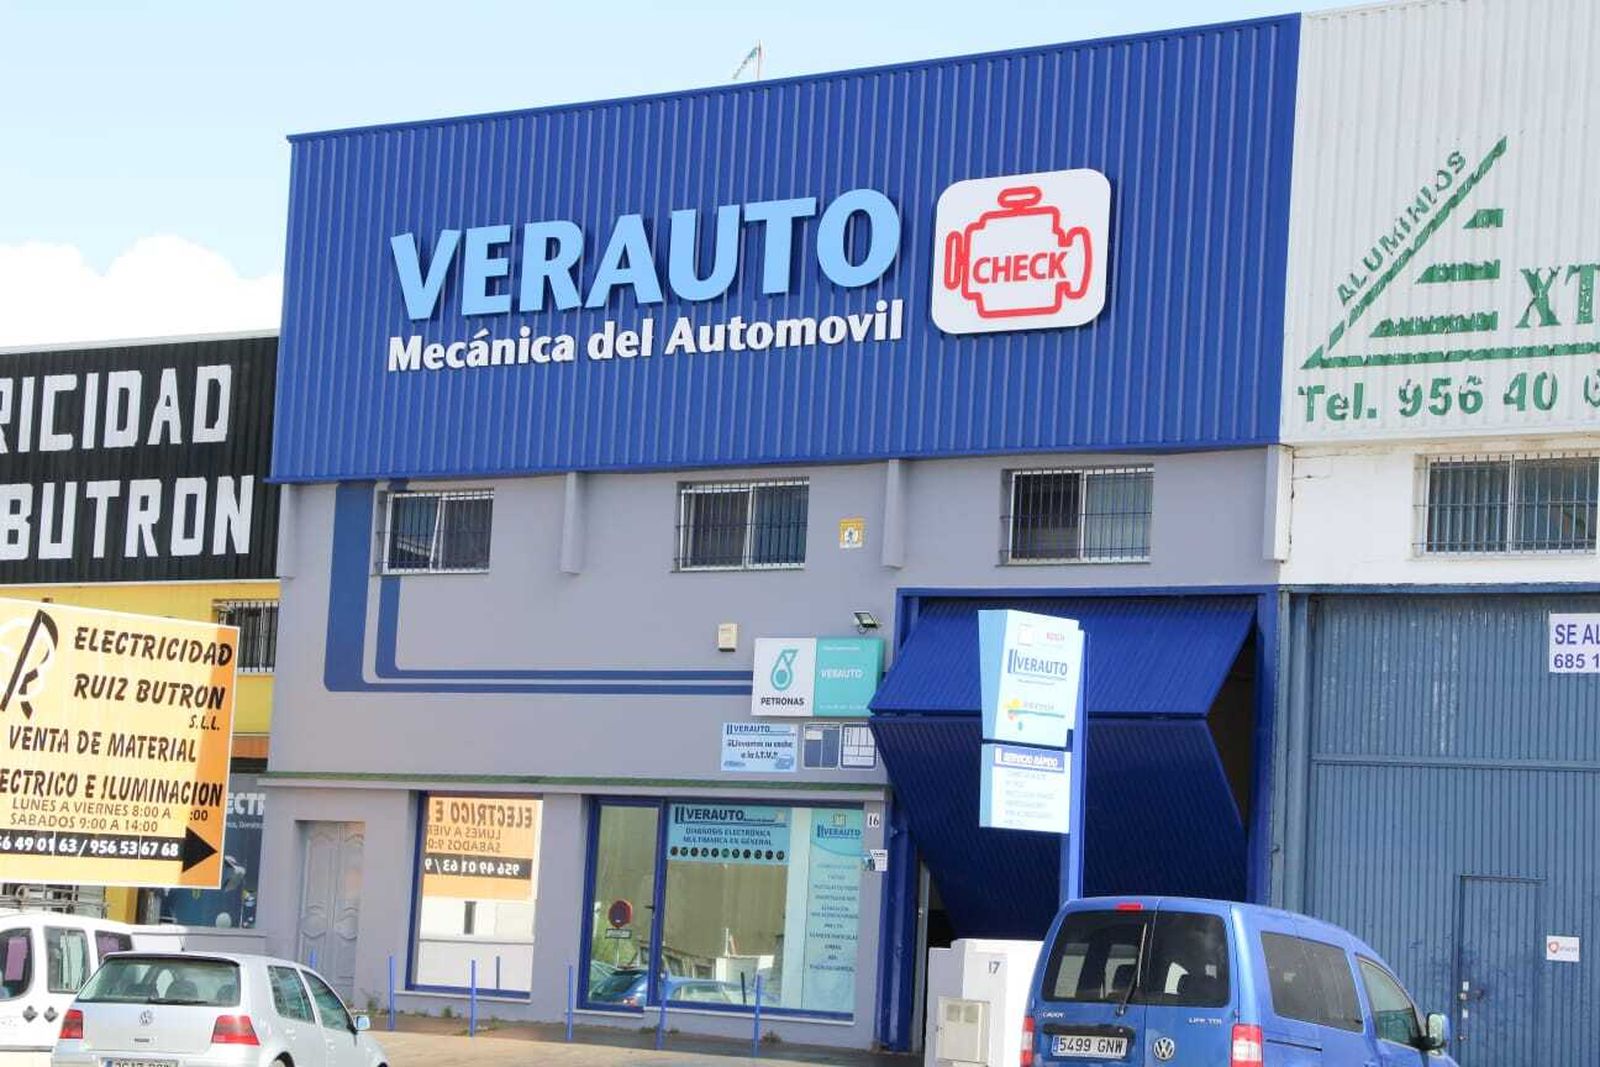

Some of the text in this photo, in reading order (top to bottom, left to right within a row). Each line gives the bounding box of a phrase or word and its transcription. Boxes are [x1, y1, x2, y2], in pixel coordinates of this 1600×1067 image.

[1337, 151, 1466, 306] ALUMINIOS
[390, 188, 901, 321] VERAUTO
[973, 252, 1068, 284] CHECK
[387, 299, 903, 372] Mecánica del Automovil
[1298, 382, 1377, 422] Tel.
[1398, 375, 1483, 417] 956
[1503, 371, 1558, 411] 40
[0, 475, 254, 561] BUTRON
[1555, 624, 1577, 645] SE
[75, 626, 233, 666] ELECTRICIDAD
[1016, 656, 1068, 676] VERAUTO
[1554, 653, 1585, 668] 685
[820, 669, 863, 679] VERAUTO
[74, 673, 226, 710] RUIZ BUTRON
[760, 697, 805, 706] PETRONAS
[189, 714, 221, 731] S.L.L.
[734, 725, 770, 733] VERAUTO
[9, 725, 197, 763] VENTA DE MATERIAL
[0, 769, 224, 807] ECTRICO E ILUMINACION
[12, 797, 56, 812] LUNES
[60, 801, 70, 812] A
[74, 802, 128, 816] VIERNES
[132, 805, 158, 817] 8:00
[162, 807, 171, 819] A
[687, 808, 744, 820] VERAUTO
[10, 812, 158, 832] SABADOS 9:00 A 14:00
[868, 813, 879, 827] 16
[823, 826, 861, 837] VERAUTO
[0, 836, 11, 850] 6
[15, 837, 33, 851] 49
[37, 838, 55, 852] 01
[59, 838, 77, 852] 63
[90, 840, 117, 854] 956
[120, 840, 138, 855] 53
[141, 841, 158, 856] 67
[161, 842, 178, 857] 68
[988, 960, 1000, 975] 17
[1060, 1038, 1125, 1054] 5499 GNW
